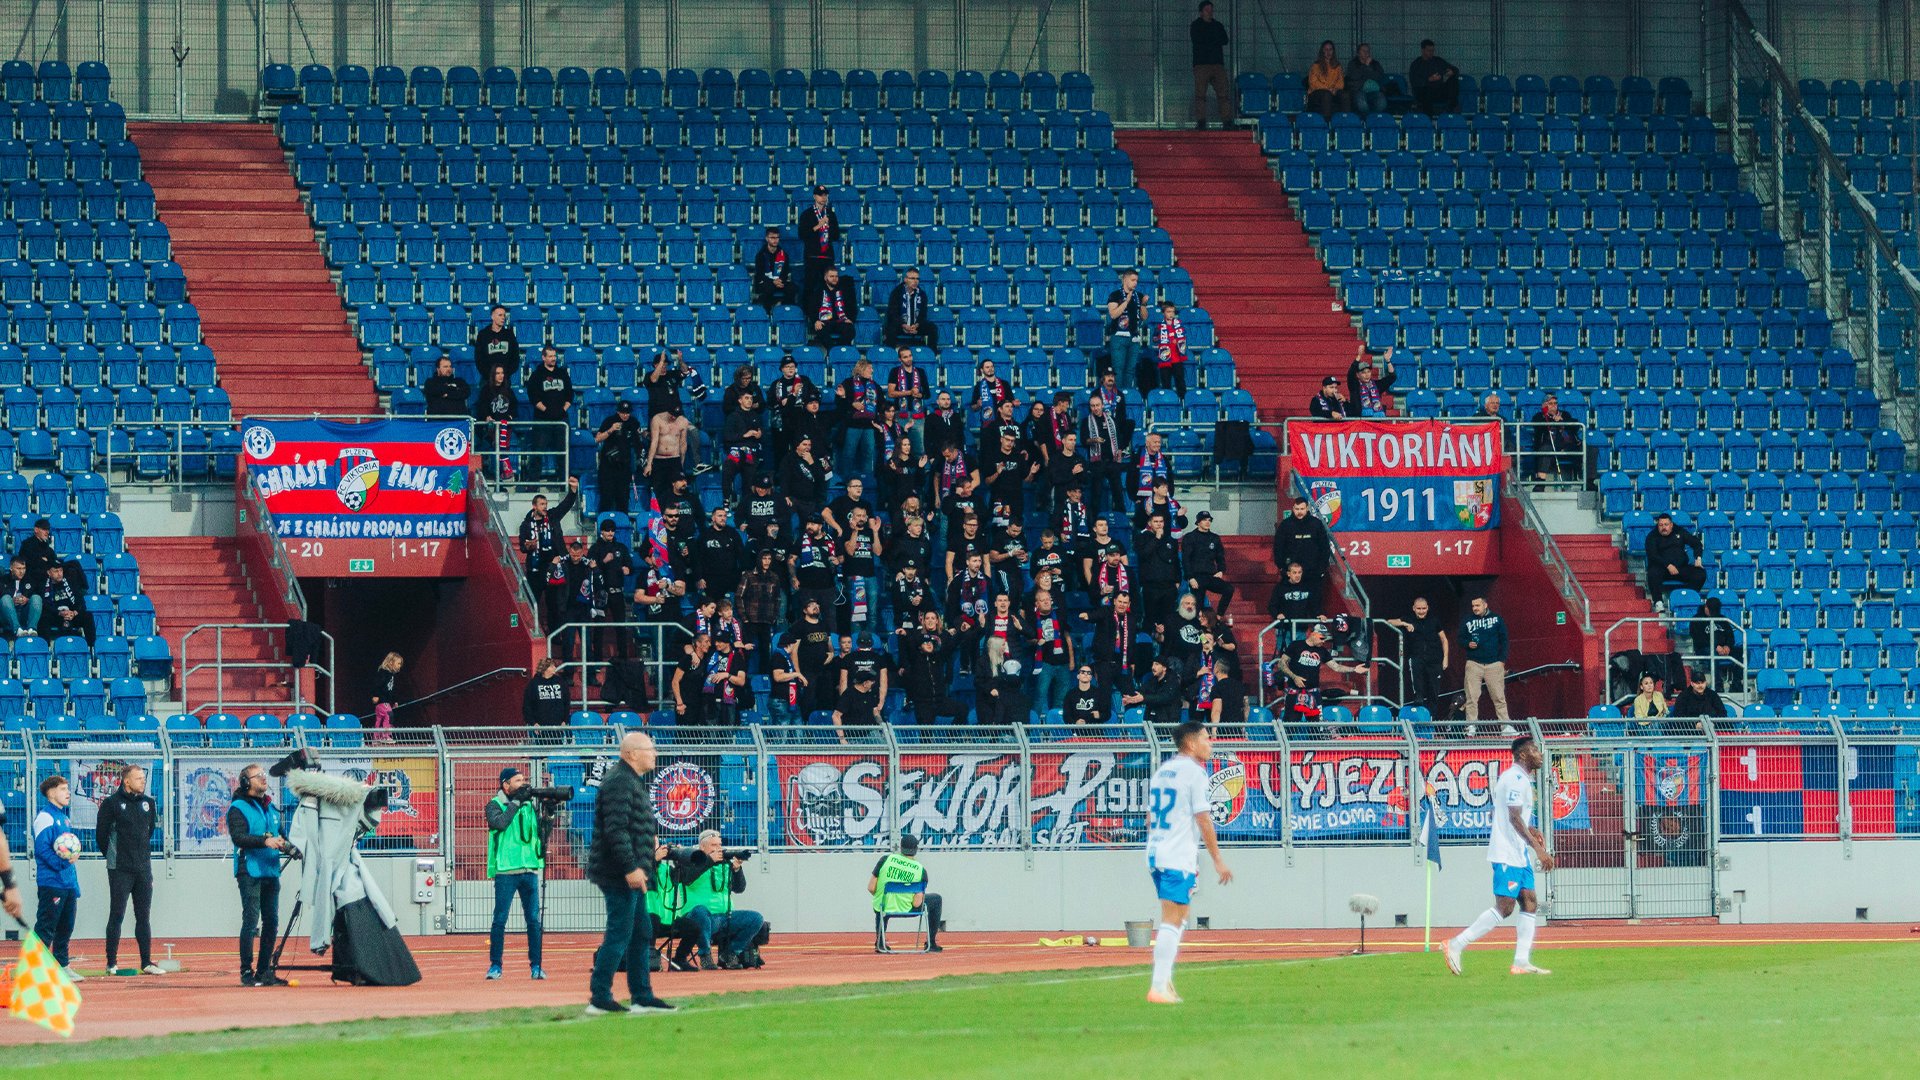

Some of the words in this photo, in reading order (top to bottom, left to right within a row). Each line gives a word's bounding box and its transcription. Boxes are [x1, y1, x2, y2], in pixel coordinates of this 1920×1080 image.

[1300, 427, 1492, 468] VIKTORIÁNI
[256, 453, 327, 499] CHRÁST
[337, 484, 347, 496] FC
[344, 462, 378, 483] VIKTORIA
[388, 461, 438, 496] FANS
[1361, 487, 1435, 522] 1911
[306, 517, 360, 537] CHRÁSTU
[363, 520, 412, 537] PROPAD
[416, 520, 466, 537] CHLASTU
[379, 772, 396, 784] FC
[1151, 787, 1177, 830] 32
[1252, 811, 1275, 828] MY
[1290, 814, 1322, 830] SME
[1327, 808, 1377, 827] DOMA
[886, 866, 915, 883] STEWARD
[890, 856, 919, 870] macron
